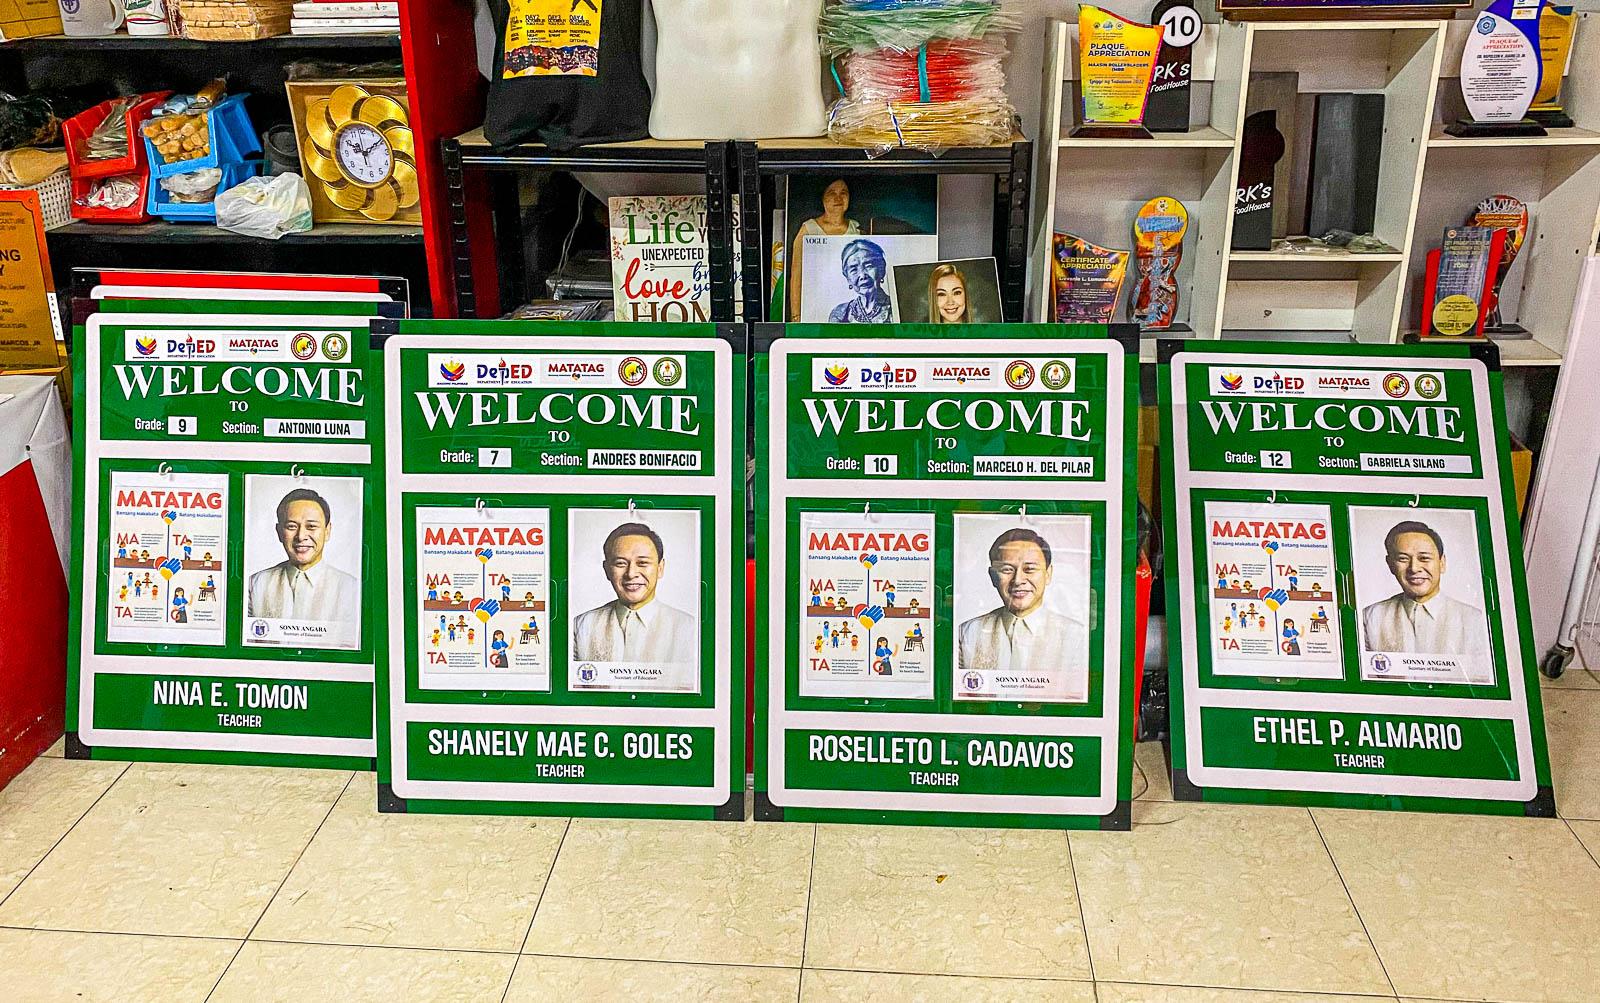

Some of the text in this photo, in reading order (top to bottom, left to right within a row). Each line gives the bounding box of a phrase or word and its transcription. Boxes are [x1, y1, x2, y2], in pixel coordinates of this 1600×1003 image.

[1165, 16, 1195, 37] 10
[626, 211, 694, 245] Life
[642, 248, 704, 261] UNEXPECTED
[620, 258, 690, 299] love
[167, 336, 215, 357] DepED
[229, 339, 278, 348] MATATAG
[477, 361, 532, 382] DepED
[548, 364, 604, 373] MATATAG
[861, 365, 916, 386] DepED
[933, 367, 990, 376] MATATAG
[112, 364, 365, 407] WELCOME
[1253, 374, 1305, 392] DepED
[1319, 378, 1370, 386] MATATAG
[229, 400, 248, 412] TO
[414, 391, 700, 436] WELCOME
[134, 417, 187, 432] Grade: 9
[222, 421, 351, 435] Section: ANTONIO LUNA
[801, 399, 1092, 442] WELCOME
[1199, 400, 1465, 443] WELCOME
[548, 430, 570, 442] TO
[935, 437, 957, 449] TO
[1324, 436, 1344, 448] TO
[440, 450, 499, 465] Grade: 7
[541, 453, 696, 467] Section: ANDRES BONIFACIO
[826, 457, 889, 472] Grade: 10
[1225, 451, 1283, 466] Grade: 12
[1319, 456, 1445, 469] Section: GABRIELA SILANG
[927, 460, 1091, 474] Section: MARCELO H. DEL PILAR
[117, 490, 222, 509] MATATAG
[425, 527, 544, 546] MATATAG
[1212, 520, 1326, 540] MATATAG
[116, 533, 139, 545] MA
[809, 532, 929, 552] MATATAG
[1215, 563, 1240, 575] MA
[426, 573, 451, 586] MA
[809, 579, 835, 592] MA
[114, 606, 132, 618] TA
[1220, 637, 1240, 650] TA
[427, 652, 447, 664] TA
[809, 658, 830, 671] TA
[153, 680, 308, 710] NINA E. TOMON
[217, 714, 262, 728] TEACHER
[1253, 716, 1463, 750] ETHEL P. ALMARIO
[428, 729, 693, 760] SHANELY MAE C. GOLES
[809, 734, 1074, 769] ROSELLETO L. CADAVOS
[1333, 753, 1385, 768] TEACHER
[536, 764, 584, 778] TEACHER
[909, 771, 959, 786] TEACHER
